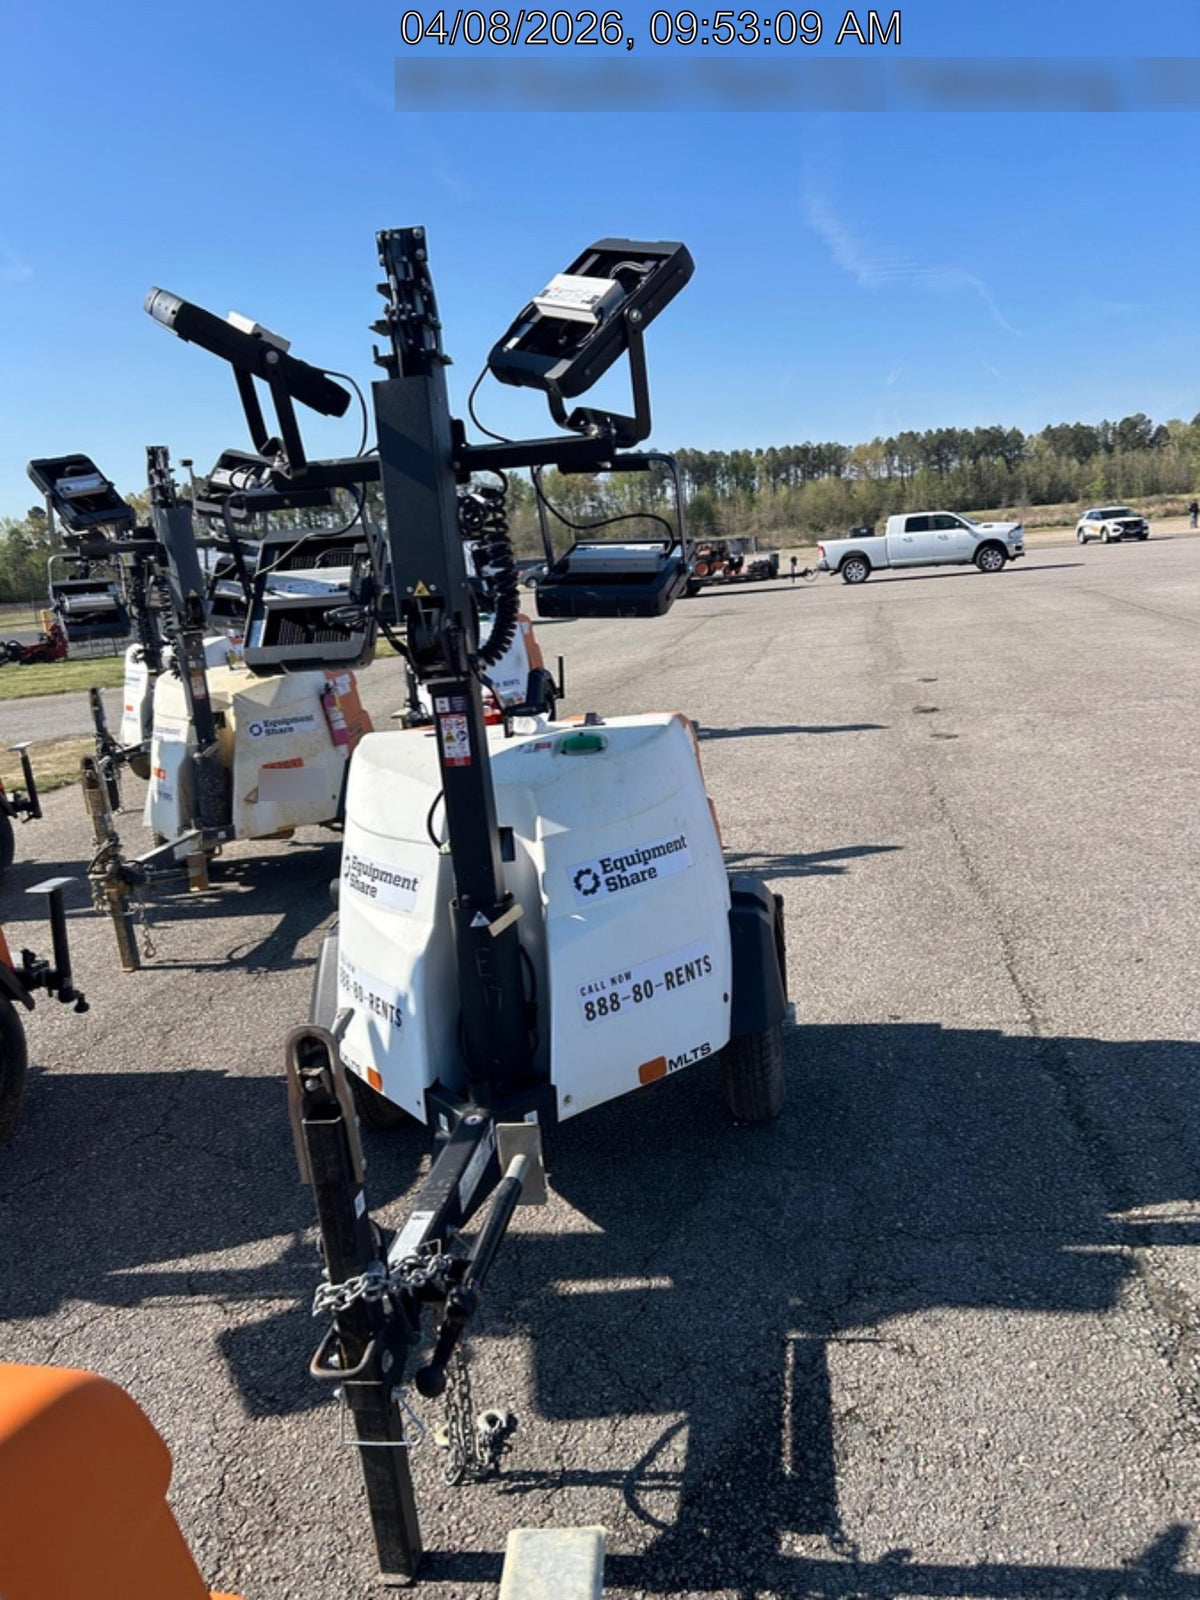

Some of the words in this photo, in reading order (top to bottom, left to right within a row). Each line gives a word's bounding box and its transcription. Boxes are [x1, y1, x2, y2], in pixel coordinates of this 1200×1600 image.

[598, 834, 687, 874] Equipment
[351, 855, 419, 892] Equipment
[604, 866, 657, 893] Share
[579, 980, 606, 997] CALL
[610, 970, 632, 986] NOW
[584, 954, 712, 1021] 888-80-RENTS
[667, 1042, 712, 1071] MLTS
